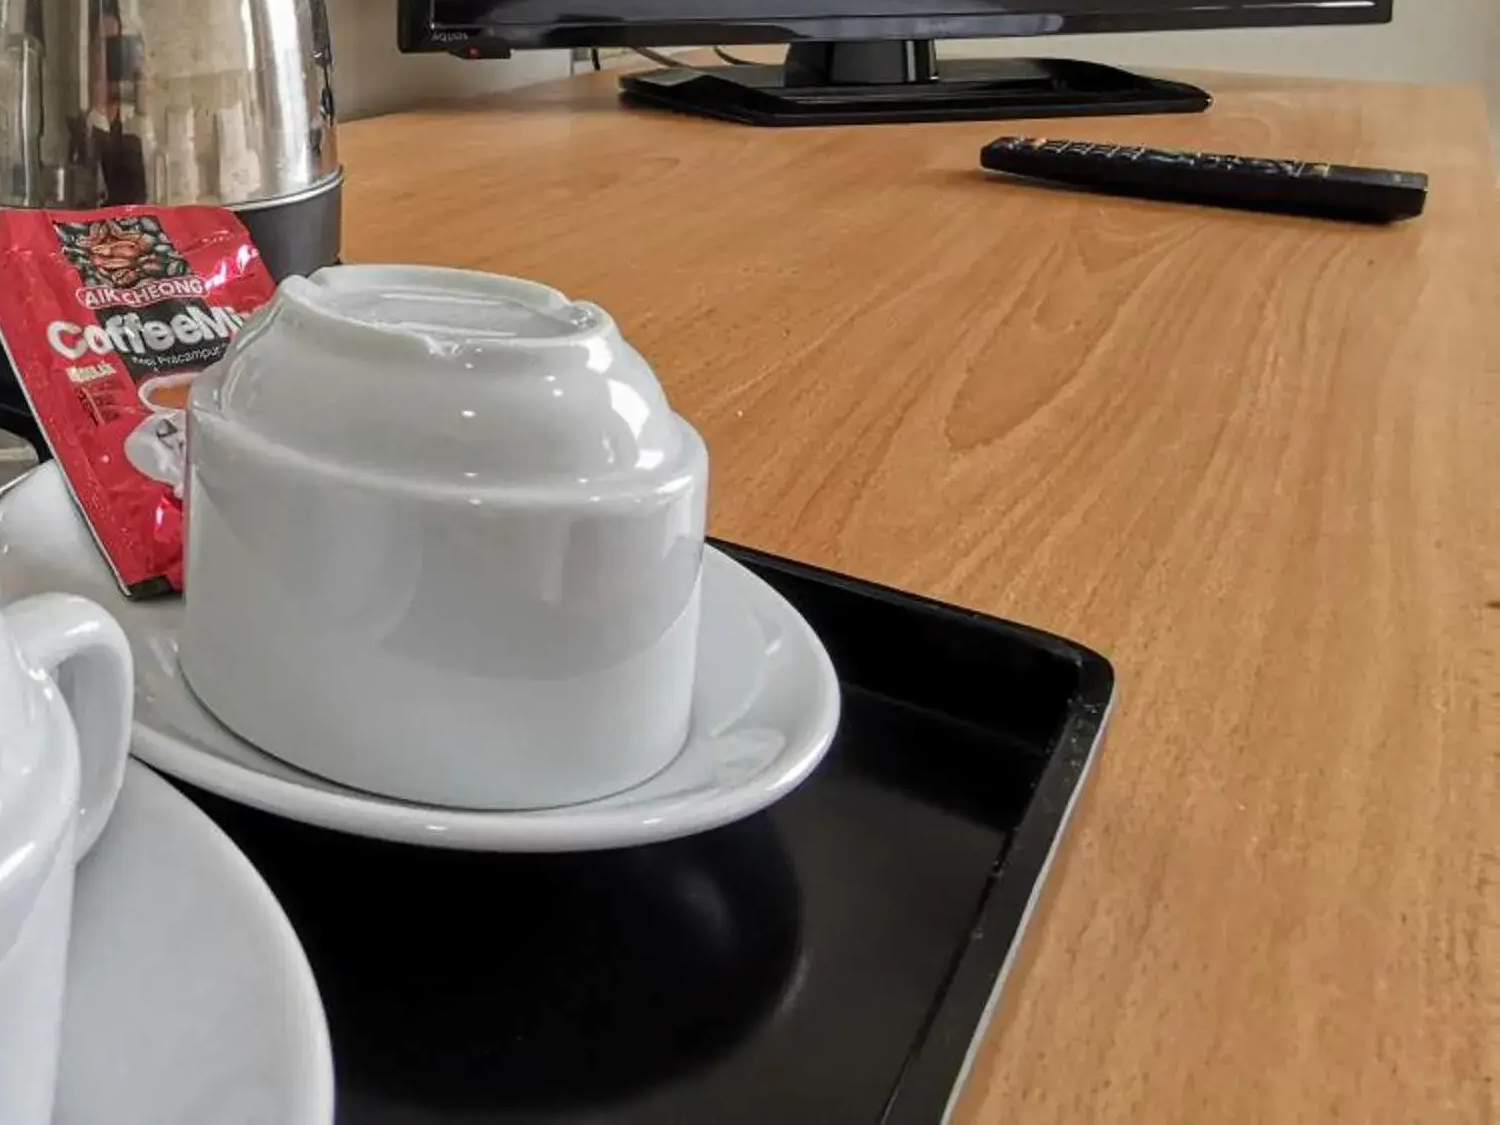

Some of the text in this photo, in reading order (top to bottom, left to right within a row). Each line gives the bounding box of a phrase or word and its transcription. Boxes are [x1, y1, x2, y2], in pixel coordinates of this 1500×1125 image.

[84, 278, 203, 307] AIK CHEONG
[47, 306, 245, 360] CoffeeMi
